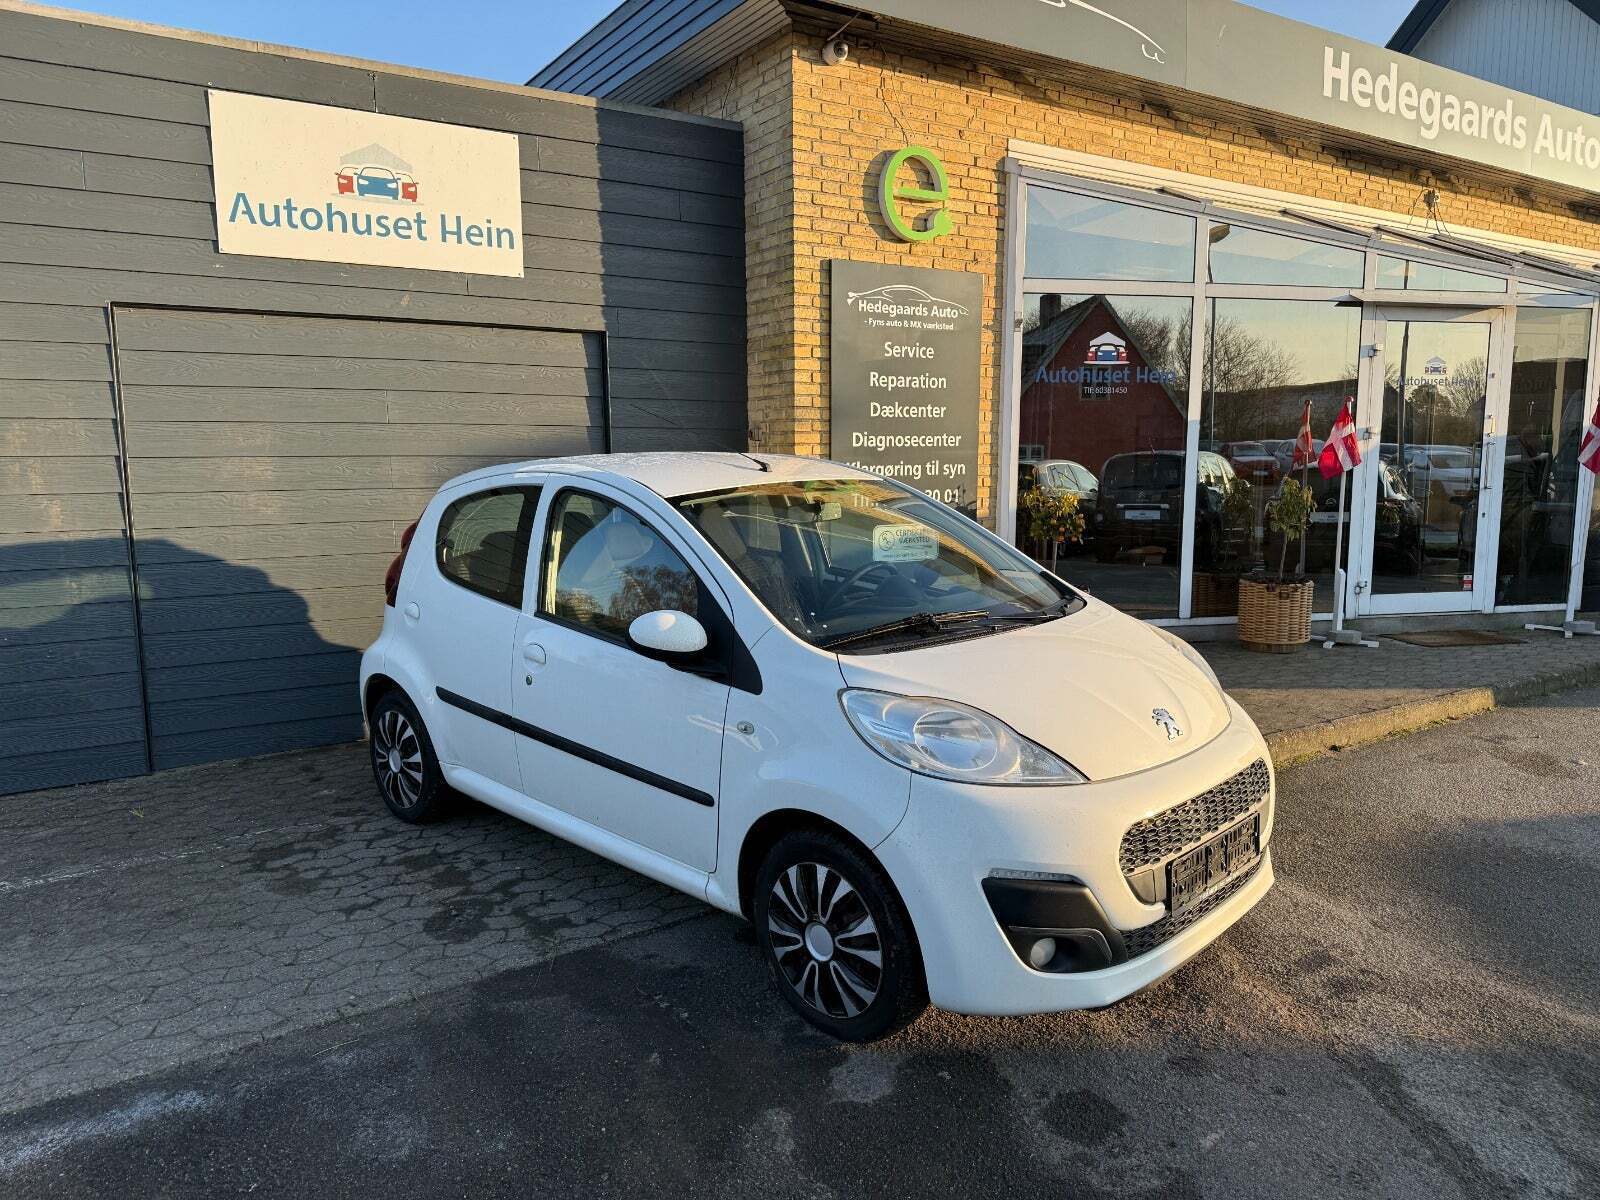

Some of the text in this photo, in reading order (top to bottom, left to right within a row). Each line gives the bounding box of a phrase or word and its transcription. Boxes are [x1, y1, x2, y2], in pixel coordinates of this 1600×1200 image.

[1322, 46, 1600, 170] Hedegaards Auto
[228, 192, 516, 250] Autohuset Hein
[858, 299, 959, 319] Hedegaards Auto
[868, 318, 885, 328] Fyns
[886, 319, 902, 328] auto
[903, 320, 909, 328] &
[884, 341, 935, 359] Service
[869, 371, 947, 391] Reparation
[1034, 366, 1131, 385] Autohuset
[870, 402, 947, 418] Dækcenter
[852, 432, 962, 451] Diagnosecenter
[925, 460, 939, 476] til
[943, 463, 966, 479] syn
[944, 488, 959, 503] 01
